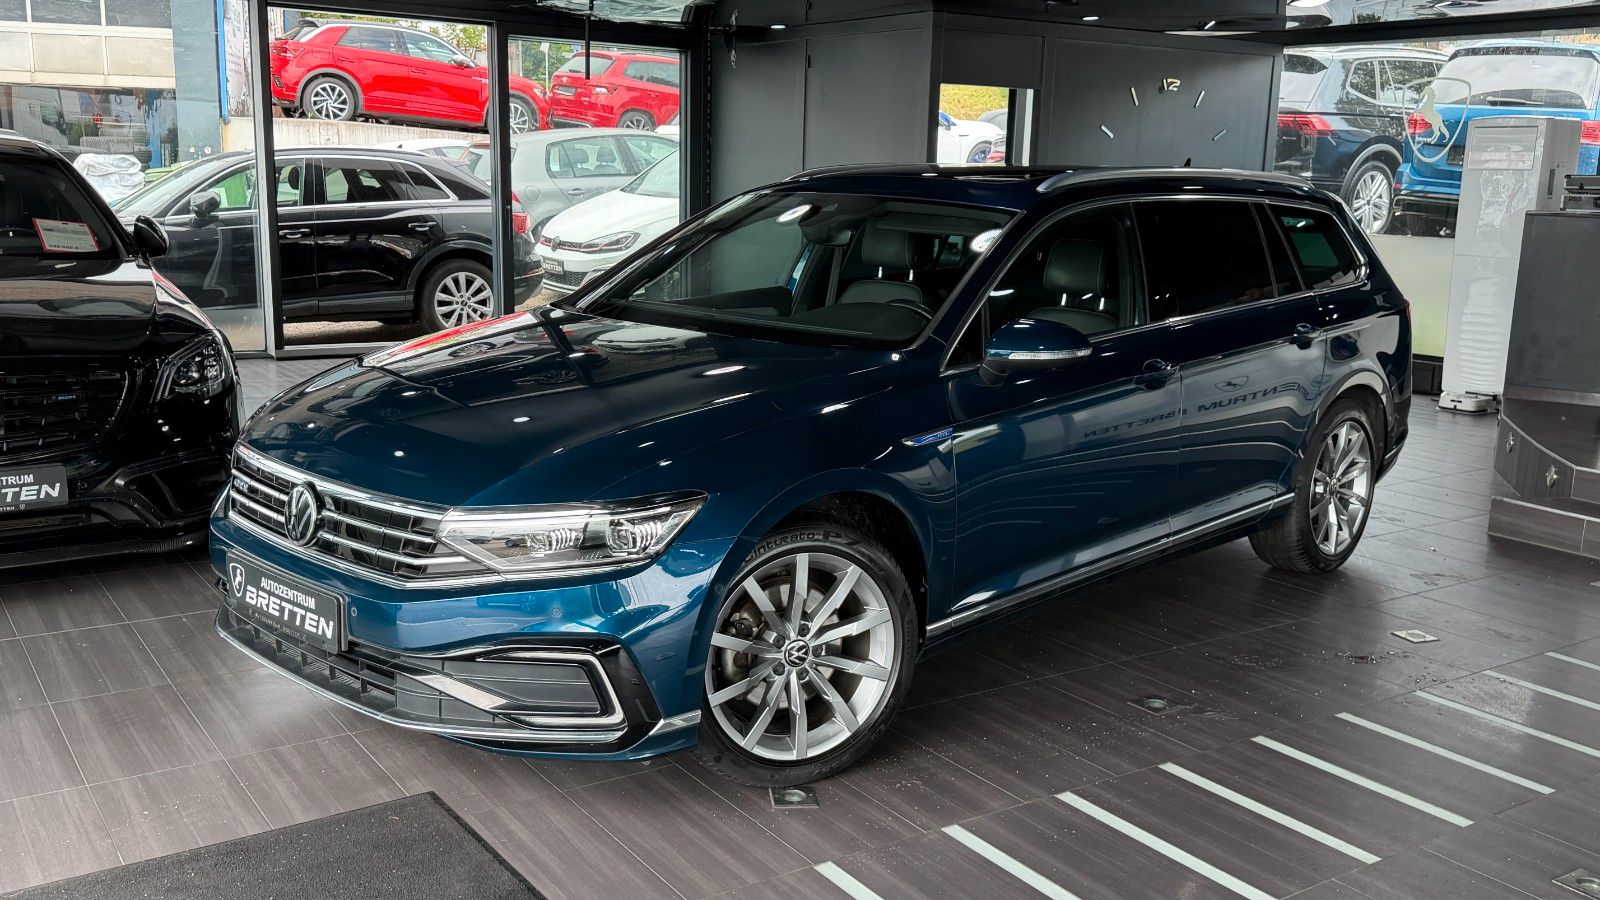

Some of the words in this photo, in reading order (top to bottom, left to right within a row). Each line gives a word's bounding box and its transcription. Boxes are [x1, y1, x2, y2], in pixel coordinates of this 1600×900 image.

[1162, 78, 1181, 91] 12
[0, 474, 34, 486] TRUM
[260, 577, 316, 610] AUTOZENTRUM
[245, 585, 334, 640] BRETTEN
